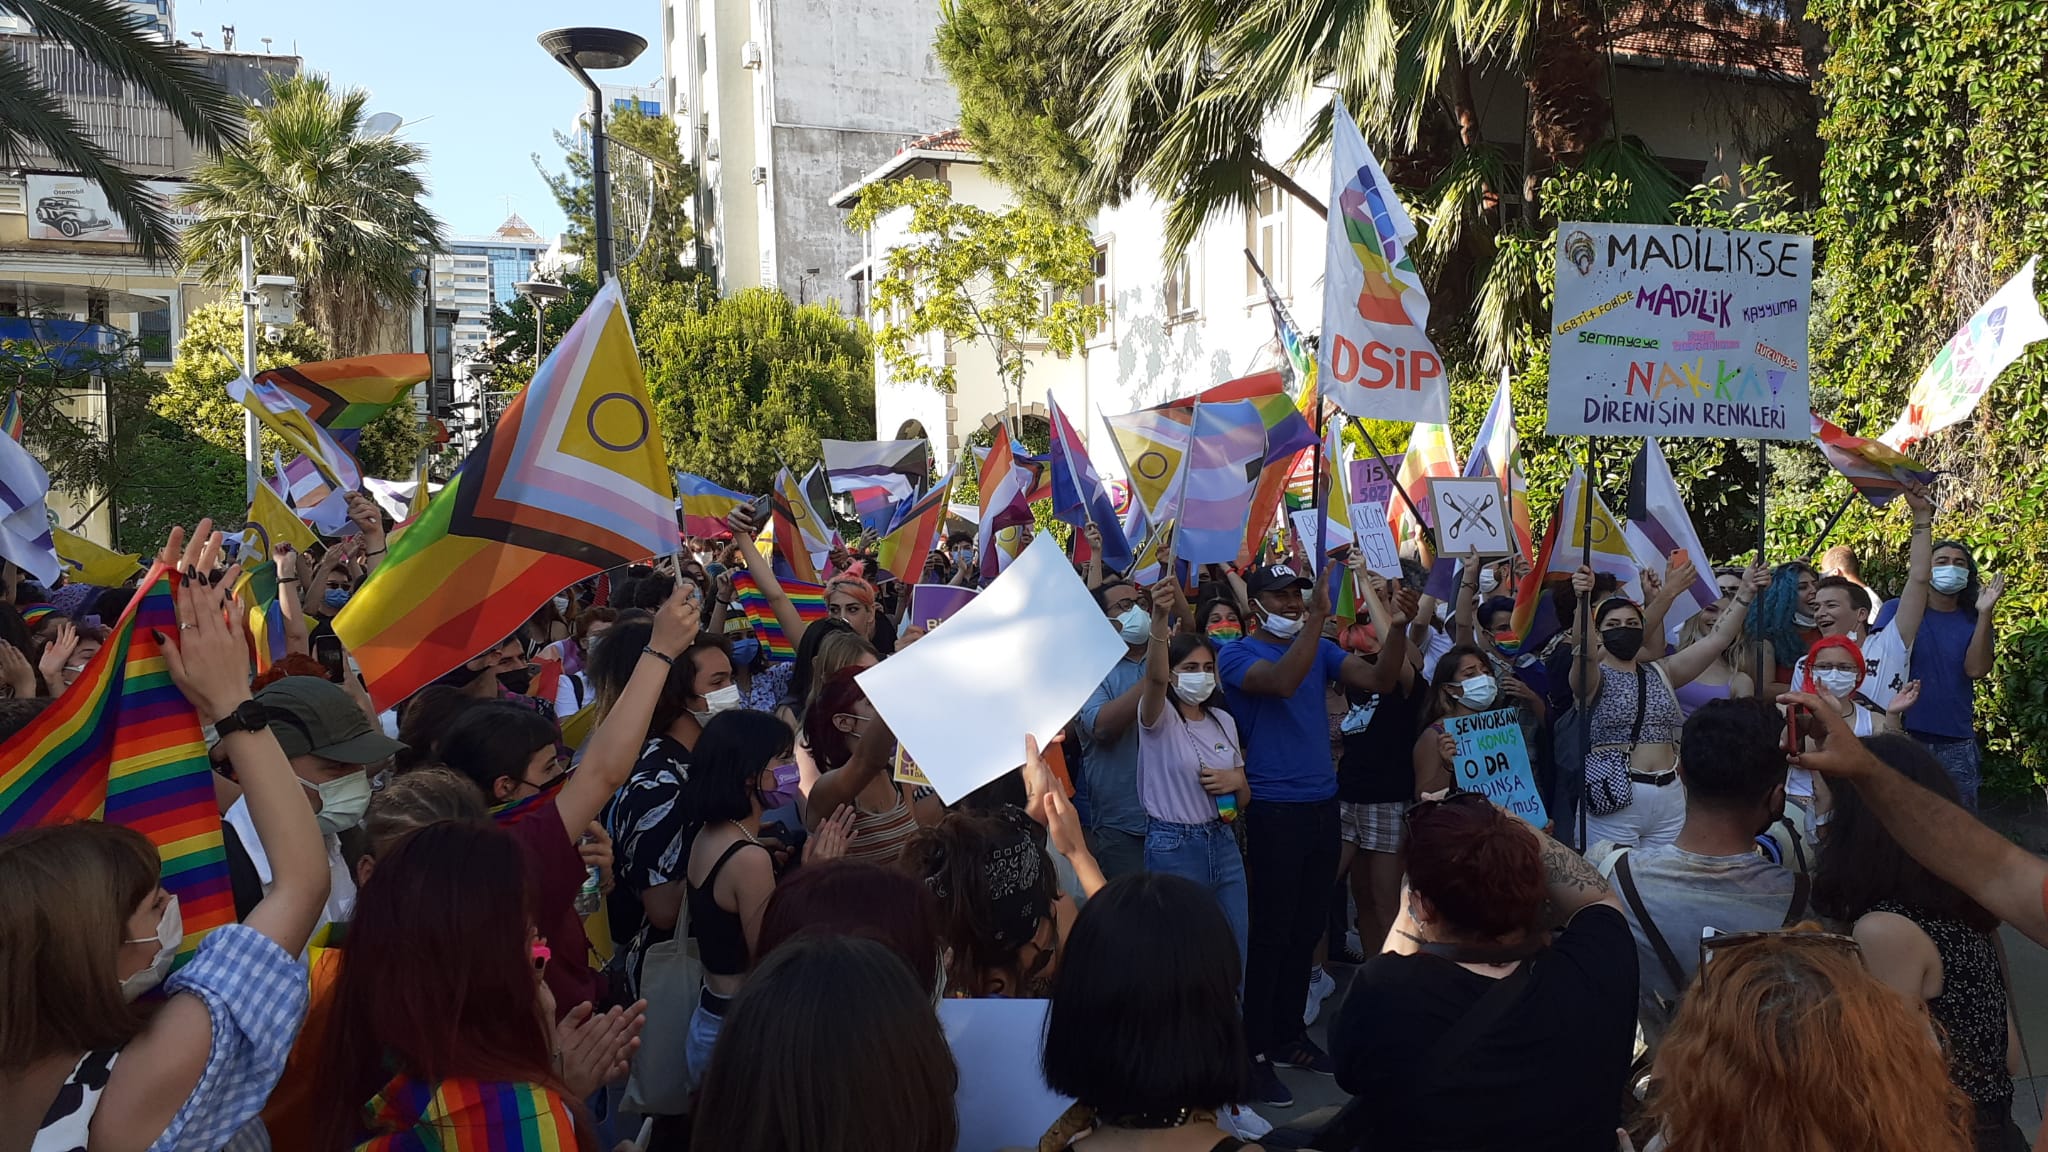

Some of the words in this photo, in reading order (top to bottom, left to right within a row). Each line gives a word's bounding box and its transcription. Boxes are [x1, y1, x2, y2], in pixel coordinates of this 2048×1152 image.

[53, 187, 85, 195] Otomobil
[1608, 228, 1800, 278] MADİLİKSE
[1635, 283, 1733, 328] MADİLİK
[1743, 298, 1798, 322] KAYYUMA
[1583, 394, 1695, 427] DİRENİŞİN
[1703, 403, 1786, 430] RENKLERİ
[1477, 729, 1517, 751] KONUŞ
[1464, 759, 1479, 779] O
[1484, 752, 1510, 776] DA
